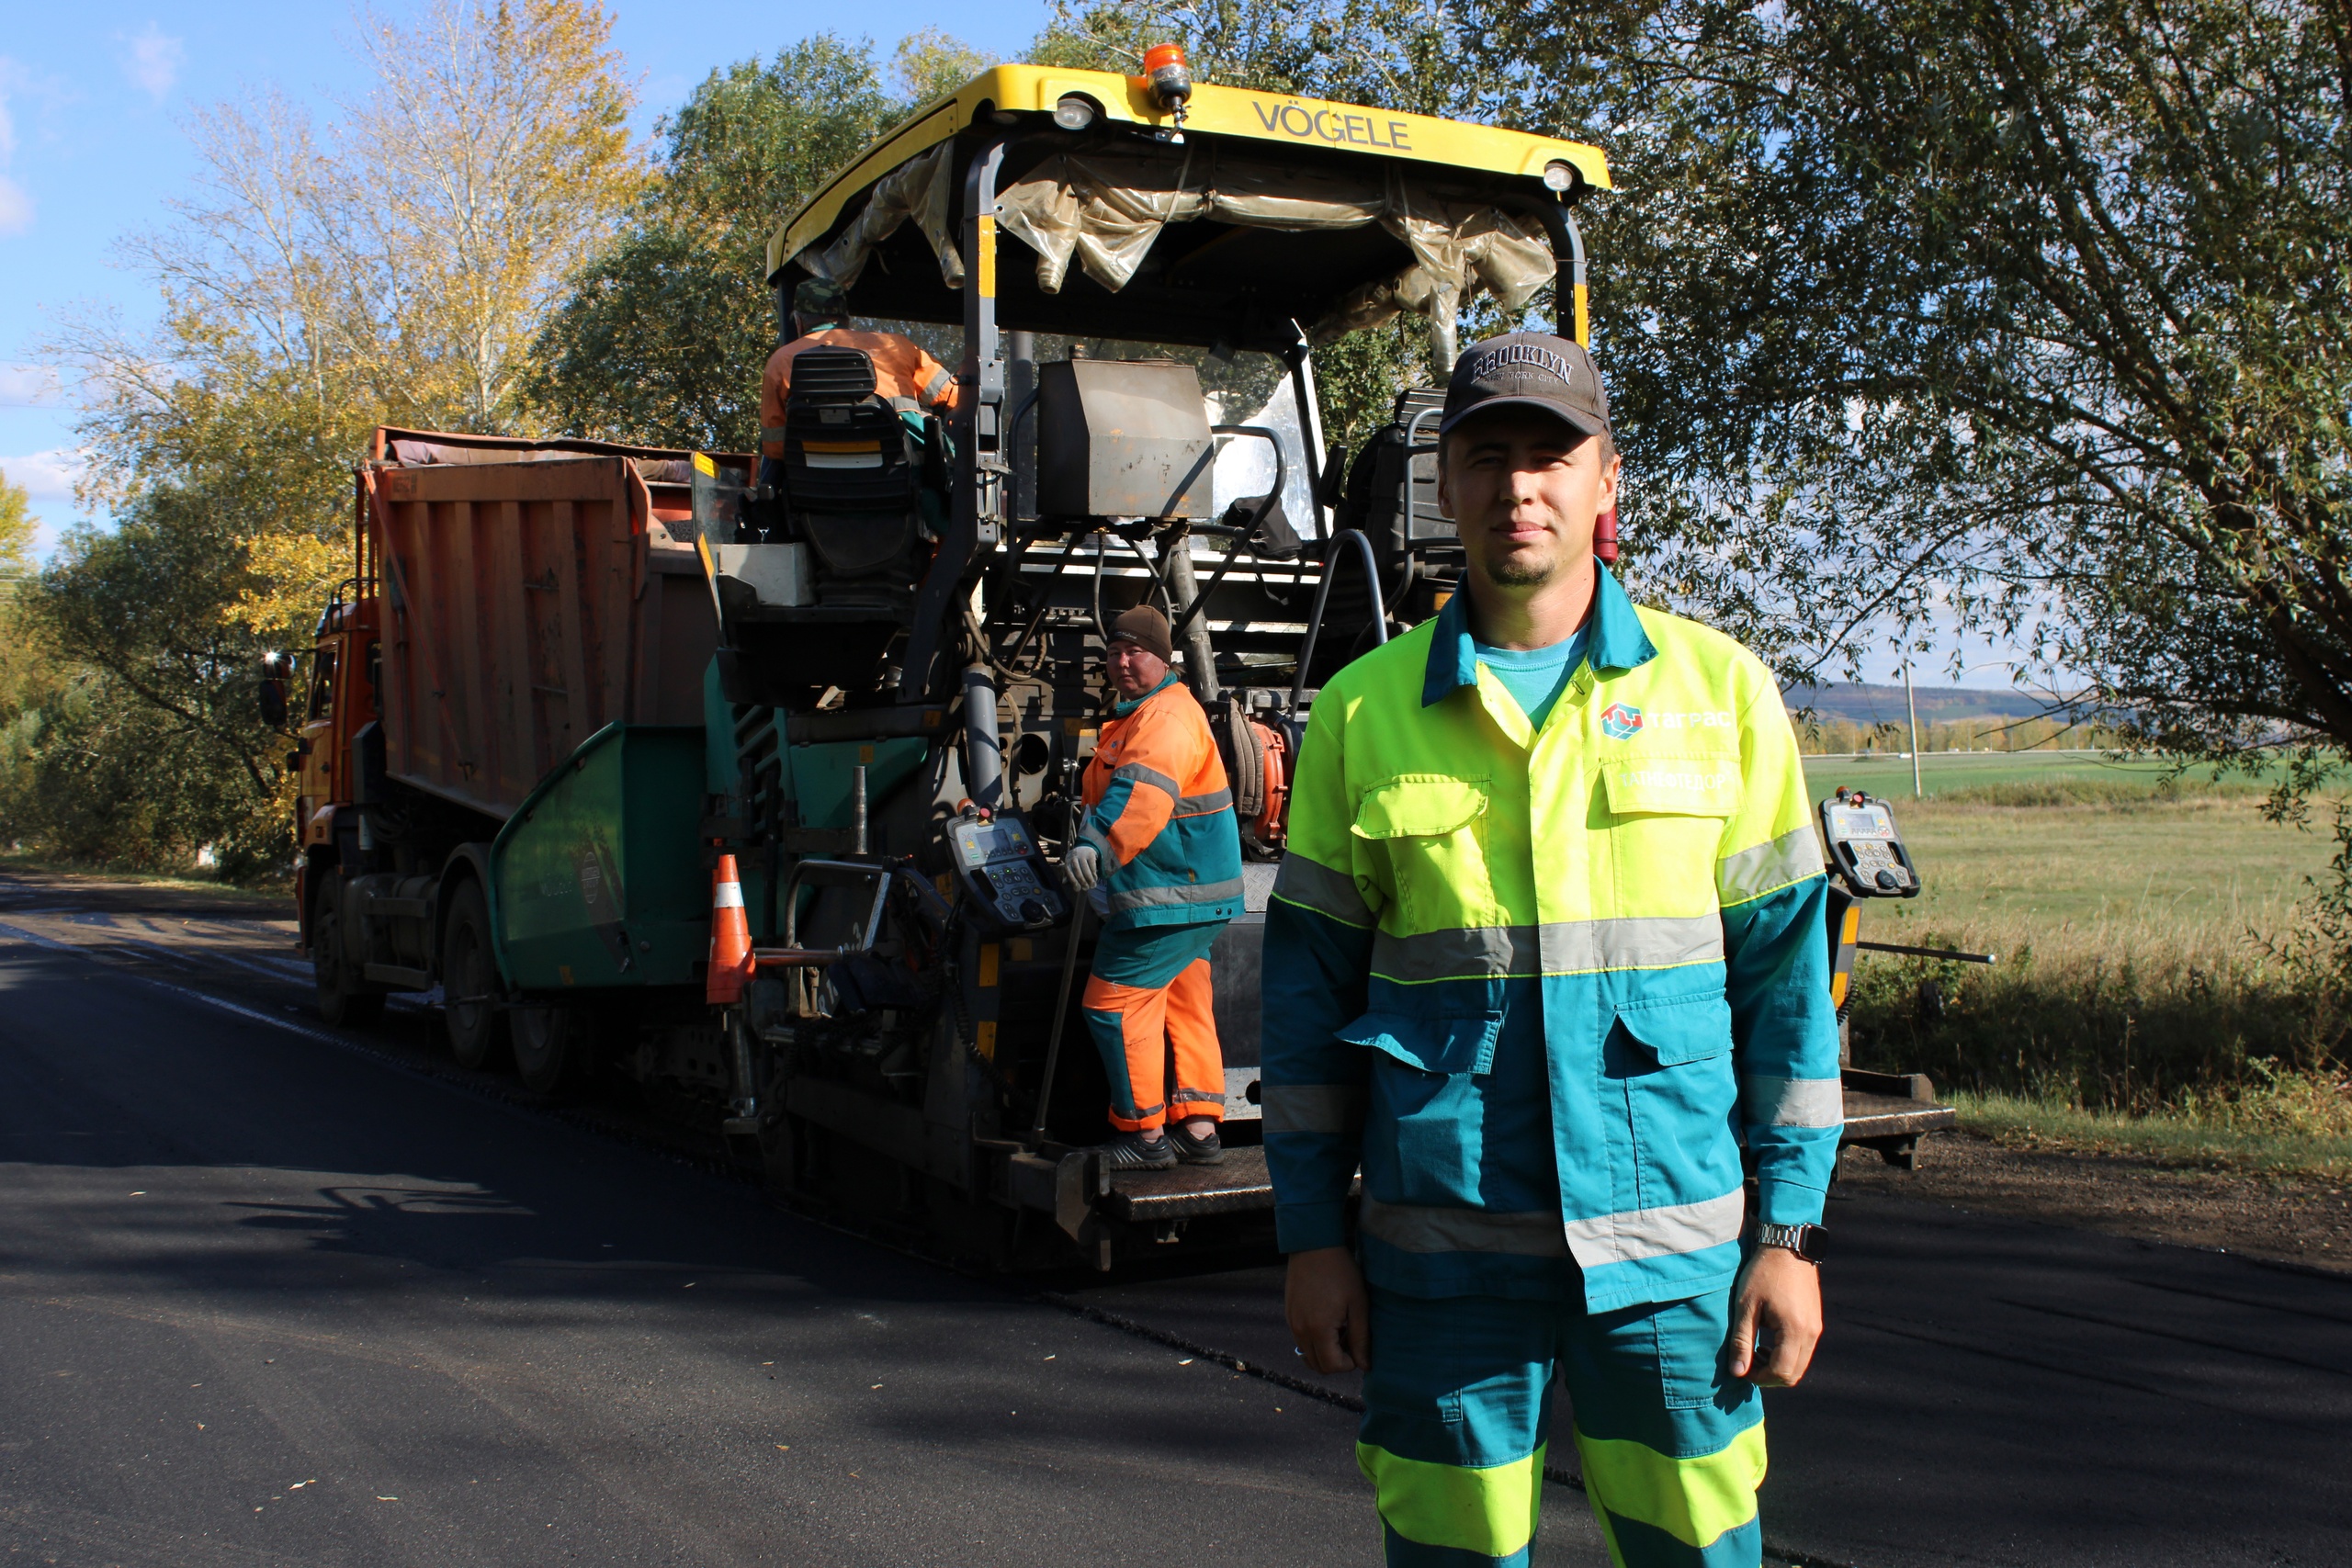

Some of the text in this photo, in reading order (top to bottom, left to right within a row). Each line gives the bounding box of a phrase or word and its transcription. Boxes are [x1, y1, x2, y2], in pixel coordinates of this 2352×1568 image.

[1252, 100, 1412, 151] VÖGELE
[1472, 344, 1574, 386] BROOKLYN
[1509, 371, 1534, 379] YORK
[1538, 374, 1559, 384] CITY
[1619, 772, 1726, 792] ТАТНЕФТЕДОР
